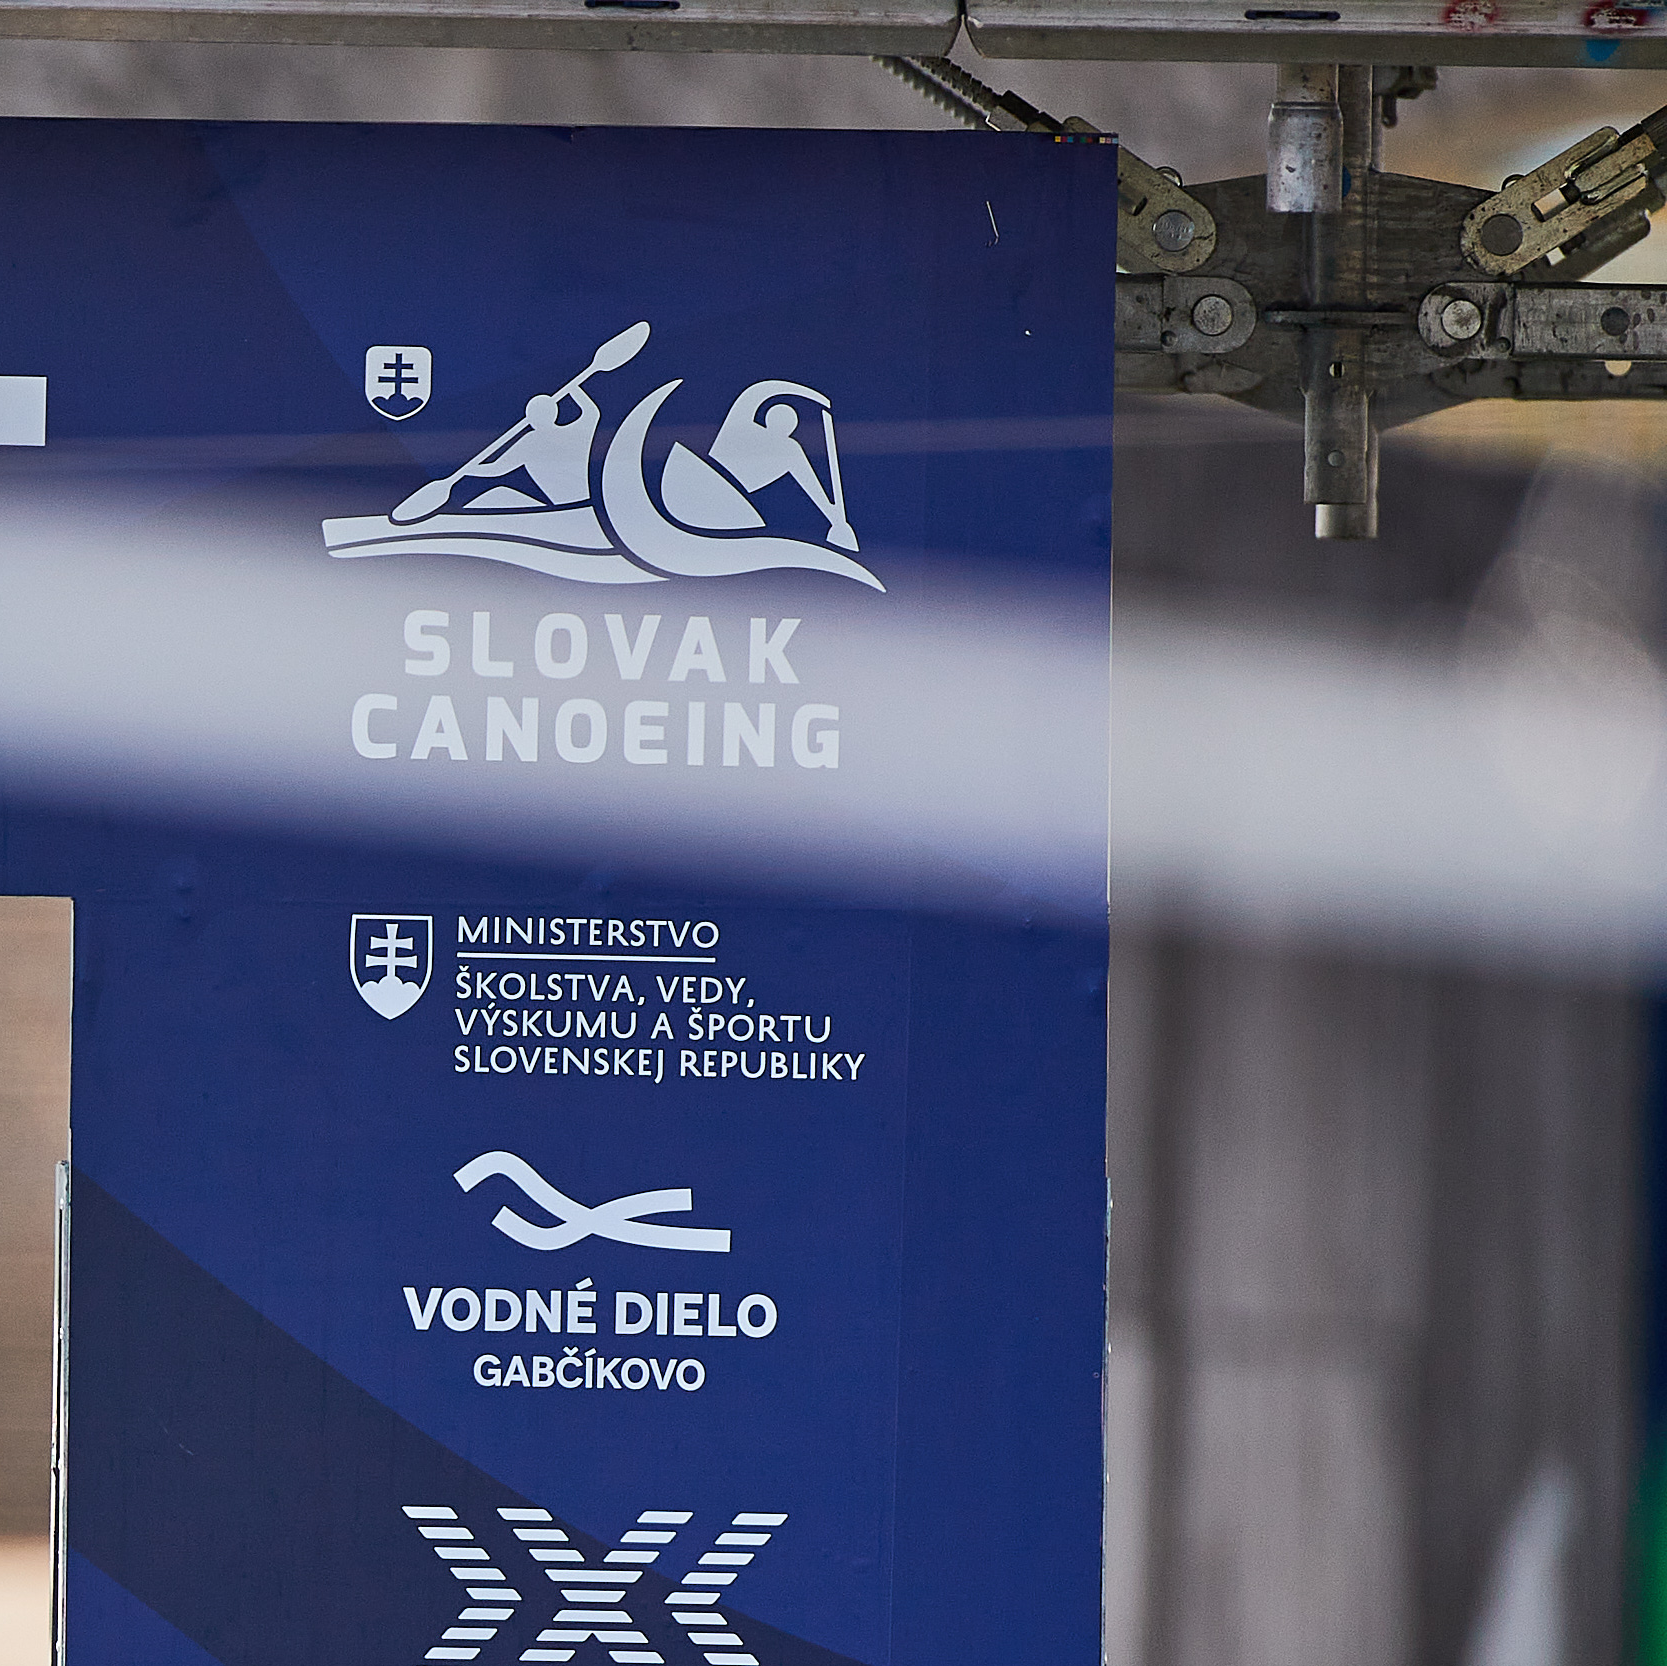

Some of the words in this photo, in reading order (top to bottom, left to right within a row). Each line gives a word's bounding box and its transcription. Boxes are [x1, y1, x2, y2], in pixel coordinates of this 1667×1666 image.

[402, 608, 803, 686] SLOVAK
[350, 692, 840, 770] CANOEING
[457, 916, 719, 949] MINISTERSTVO
[455, 965, 646, 1006] ŠKOLSTVA,
[655, 975, 755, 1009] VEDY,
[454, 1001, 637, 1039] VÝSKUMU
[650, 1012, 674, 1040] A
[688, 1006, 831, 1043] ŠPORTU
[454, 1045, 664, 1084] SLOVENSKEJ
[680, 1049, 866, 1081] REPUBLIKY
[402, 1277, 597, 1334] VODNÉ
[614, 1291, 778, 1339] DIELO
[473, 1346, 706, 1392] GABČÍKOVO
